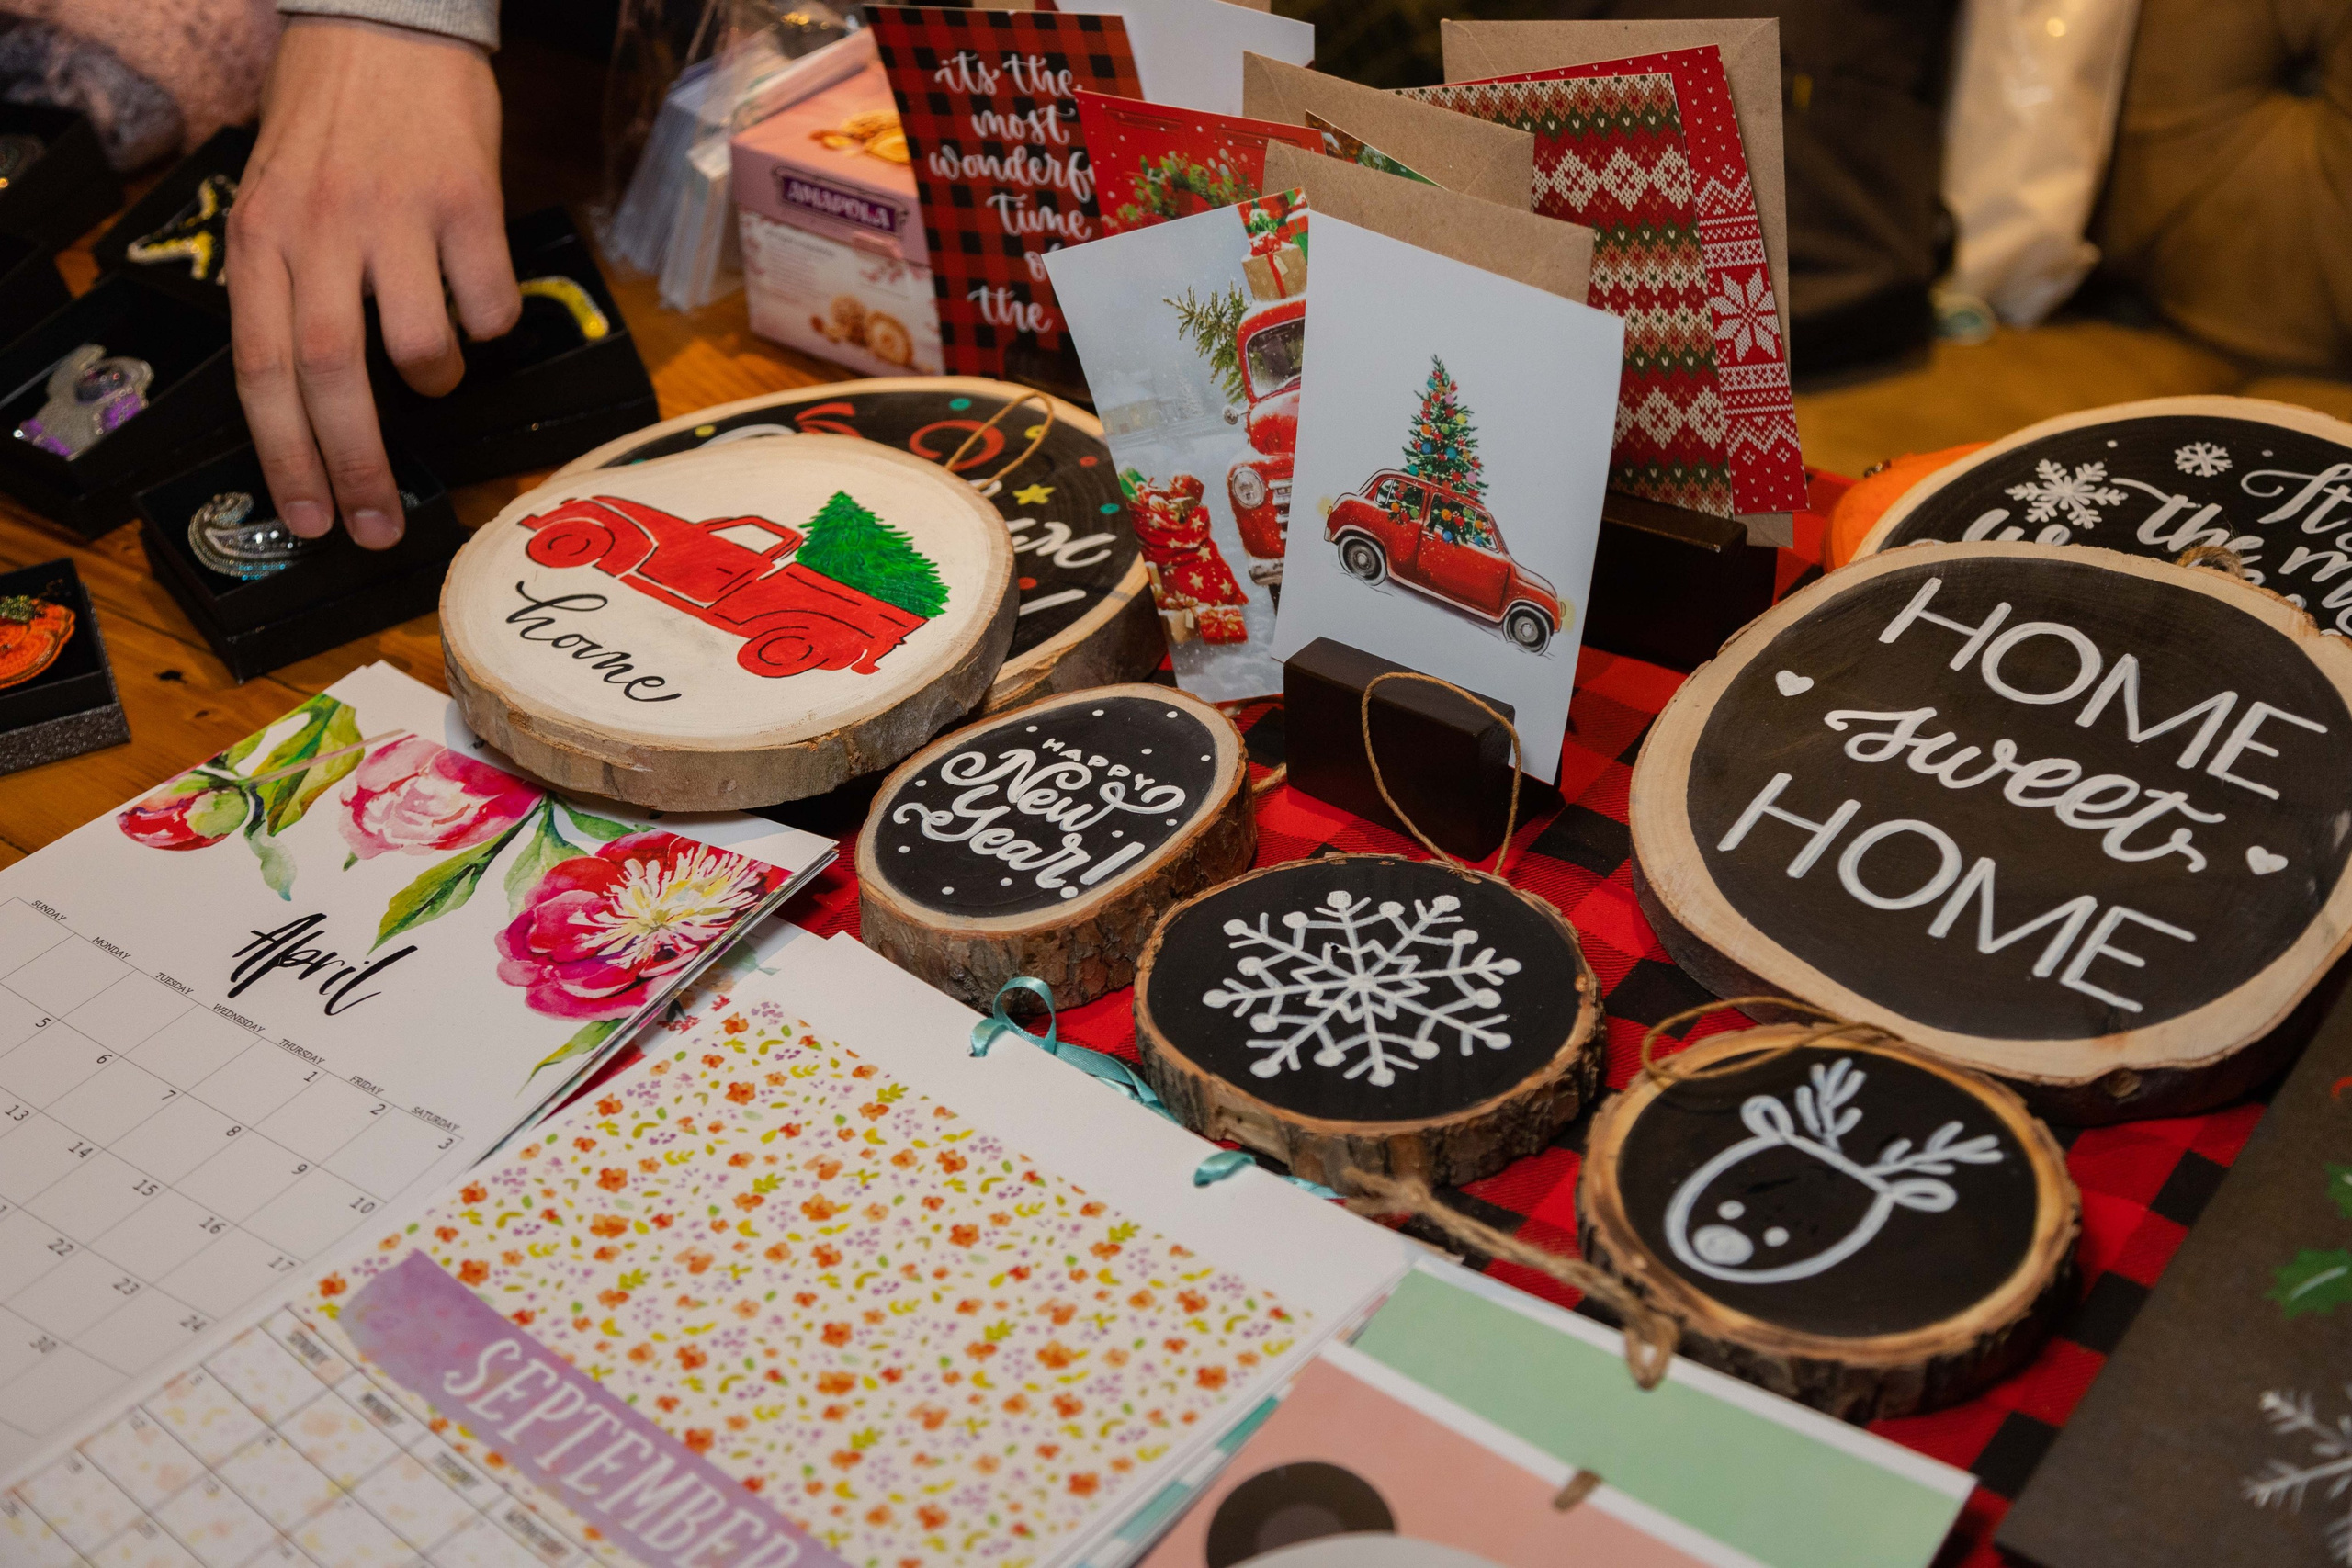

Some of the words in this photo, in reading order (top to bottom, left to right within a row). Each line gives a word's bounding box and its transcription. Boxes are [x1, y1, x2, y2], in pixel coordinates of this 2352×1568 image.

[1002, 53, 1082, 98] the
[970, 103, 1077, 145] most
[928, 144, 1096, 204] wonderf
[985, 191, 1093, 242] time
[966, 284, 1054, 333] the
[505, 580, 683, 704] home
[1878, 577, 2328, 800] HOME
[940, 747, 1187, 833] New
[1041, 737, 1156, 792] HAPPY
[891, 784, 1146, 900] Year!
[1716, 772, 2197, 1013] HOME
[227, 912, 419, 1016] April
[31, 899, 67, 922] SUNDAY
[92, 935, 132, 961] MONDAY
[154, 971, 195, 996] TUESDAY
[212, 1003, 266, 1034] WEDNESDAY
[278, 1038, 326, 1066] THURSDAY
[349, 1075, 385, 1096] FRIDAY
[410, 1105, 460, 1134] SATURDAY
[34, 1017, 51, 1029] 5
[96, 1054, 113, 1065] 6
[161, 1089, 177, 1101] 7
[225, 1125, 243, 1138] 8
[291, 1163, 309, 1176] 9
[349, 1196, 376, 1215] 10
[303, 1070, 319, 1083] 1
[370, 1103, 387, 1116] 2
[438, 1137, 455, 1151] 3
[4, 1104, 30, 1122] 13
[68, 1141, 94, 1159] 14
[132, 1179, 159, 1197] 15
[198, 1216, 226, 1235] 16
[268, 1256, 296, 1273] 17
[47, 1237, 74, 1257] 22
[112, 1277, 141, 1296] 23
